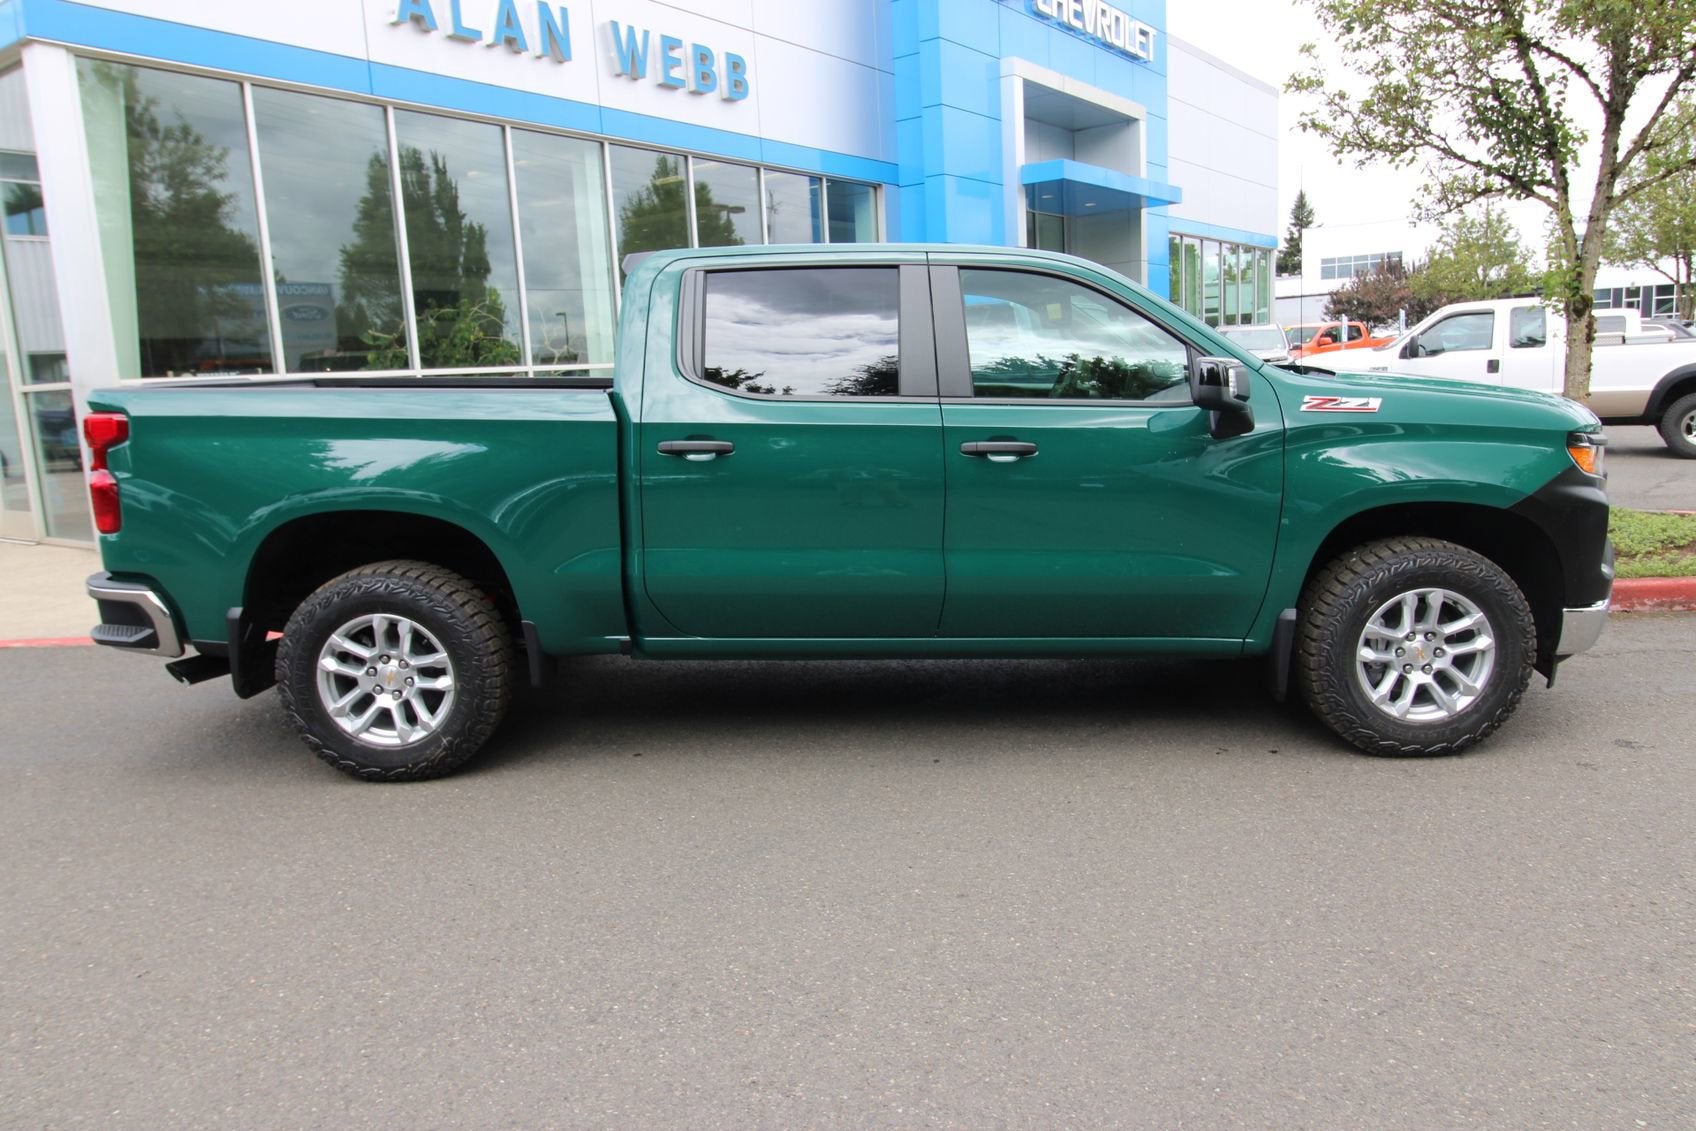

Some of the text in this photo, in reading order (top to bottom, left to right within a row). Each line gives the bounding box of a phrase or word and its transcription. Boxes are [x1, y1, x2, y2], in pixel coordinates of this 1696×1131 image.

[390, 0, 750, 102] ALAN WEBB
[1300, 395, 1382, 413] Z71
